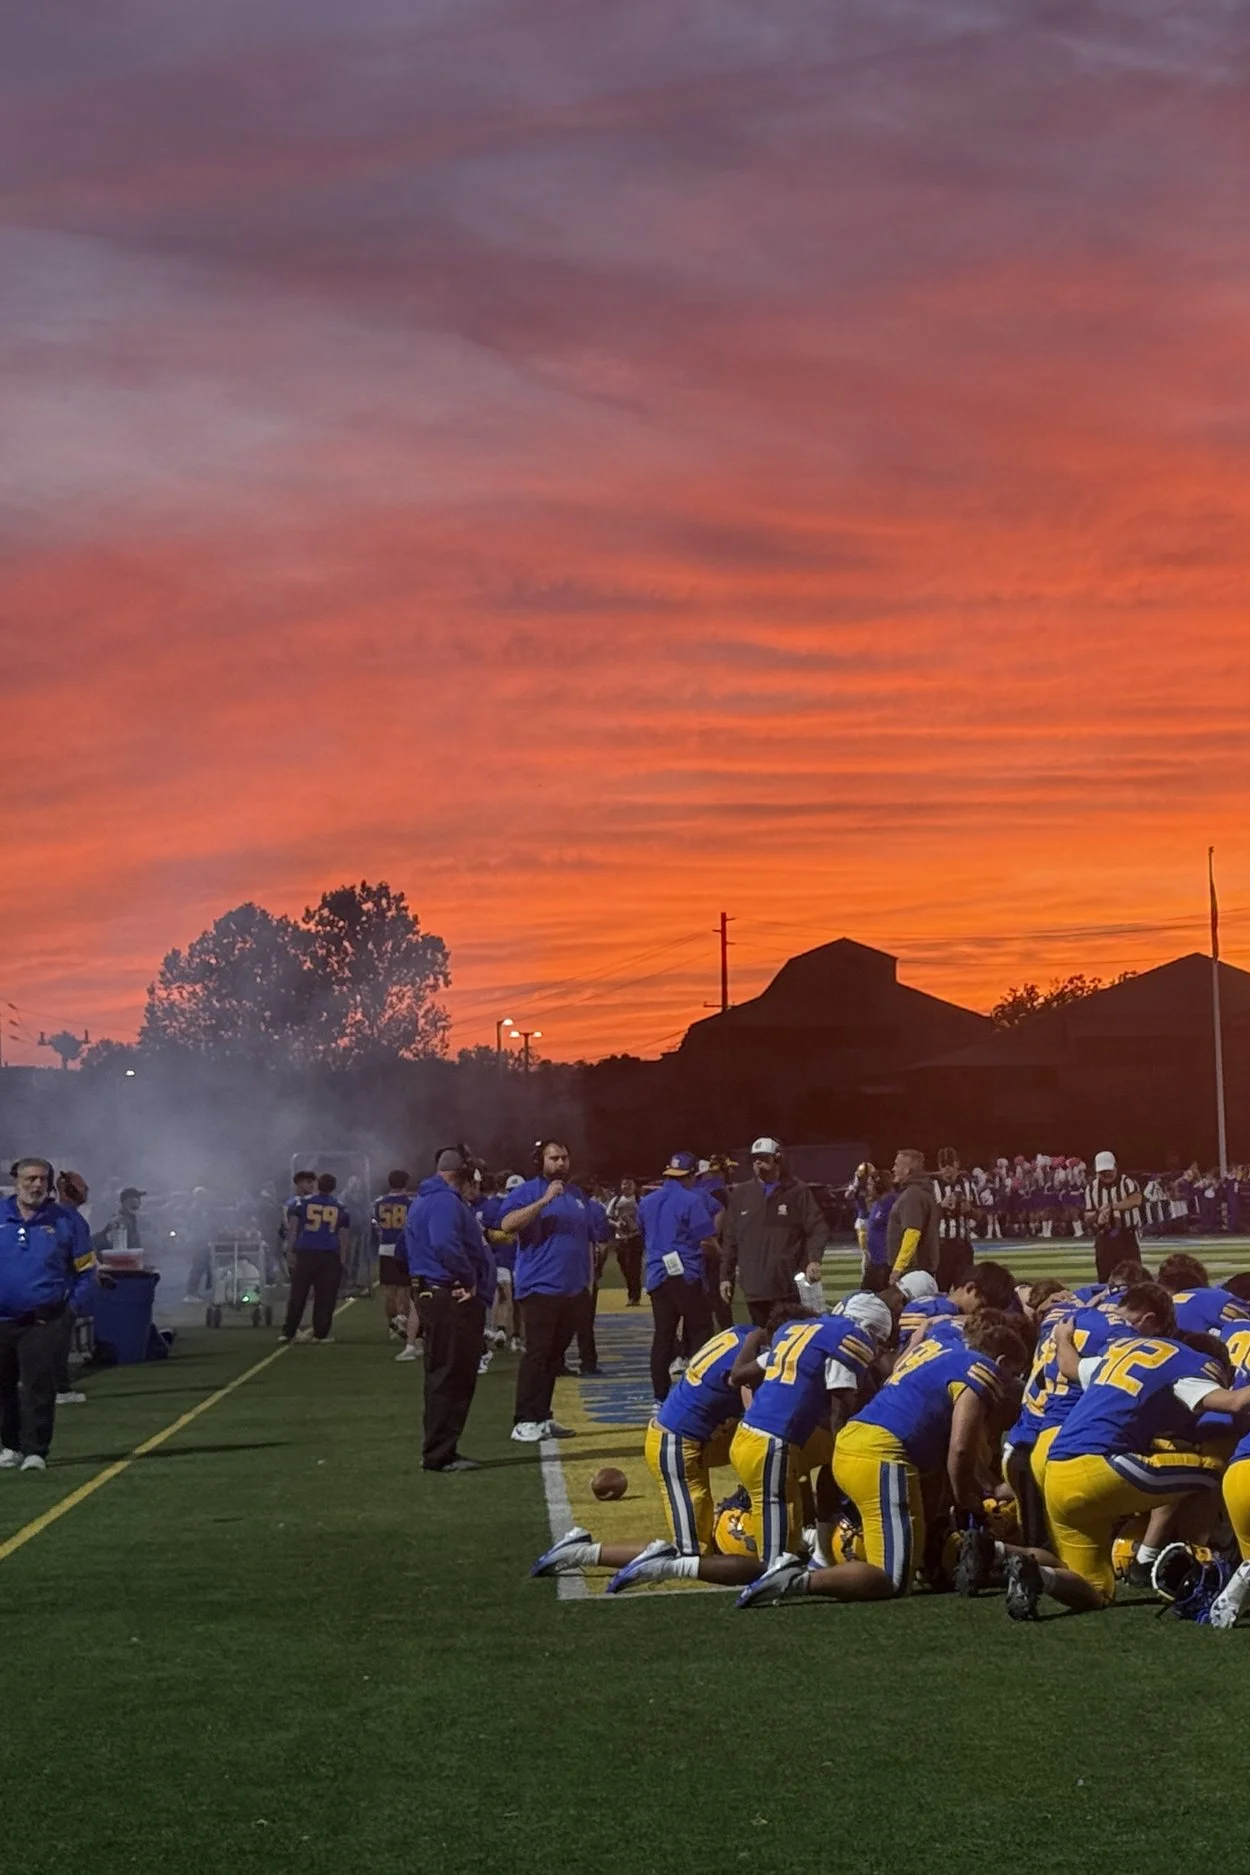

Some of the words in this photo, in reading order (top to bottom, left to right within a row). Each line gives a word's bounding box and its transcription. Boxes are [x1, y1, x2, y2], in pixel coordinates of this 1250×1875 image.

[305, 1204, 339, 1233] 59
[379, 1204, 408, 1230] 58
[764, 1323, 824, 1385] 31
